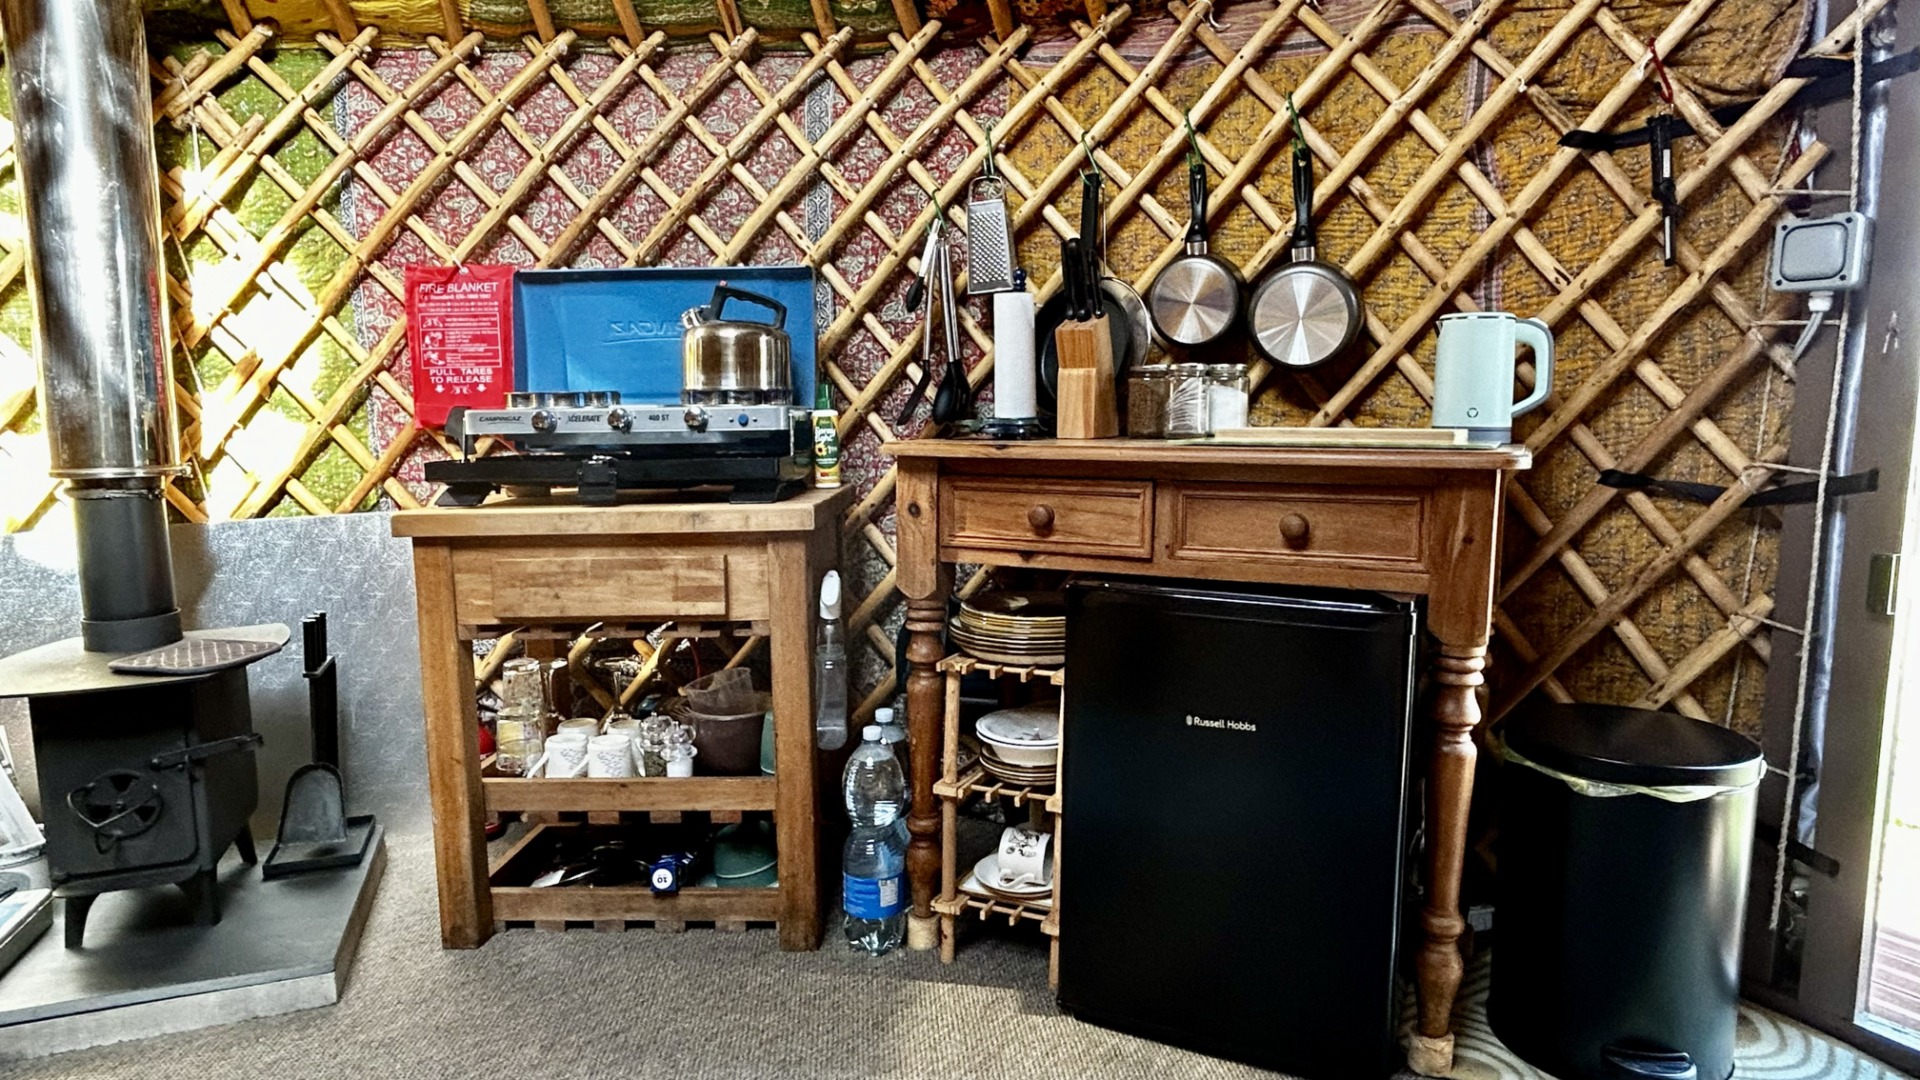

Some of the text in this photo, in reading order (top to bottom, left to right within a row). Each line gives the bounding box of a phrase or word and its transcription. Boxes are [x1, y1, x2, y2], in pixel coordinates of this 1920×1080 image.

[419, 282, 498, 294] FIRE BLANKET
[429, 367, 456, 376] PULL
[430, 375, 493, 384] TO RELEASE
[1194, 716, 1256, 731] Russell Hobbs
